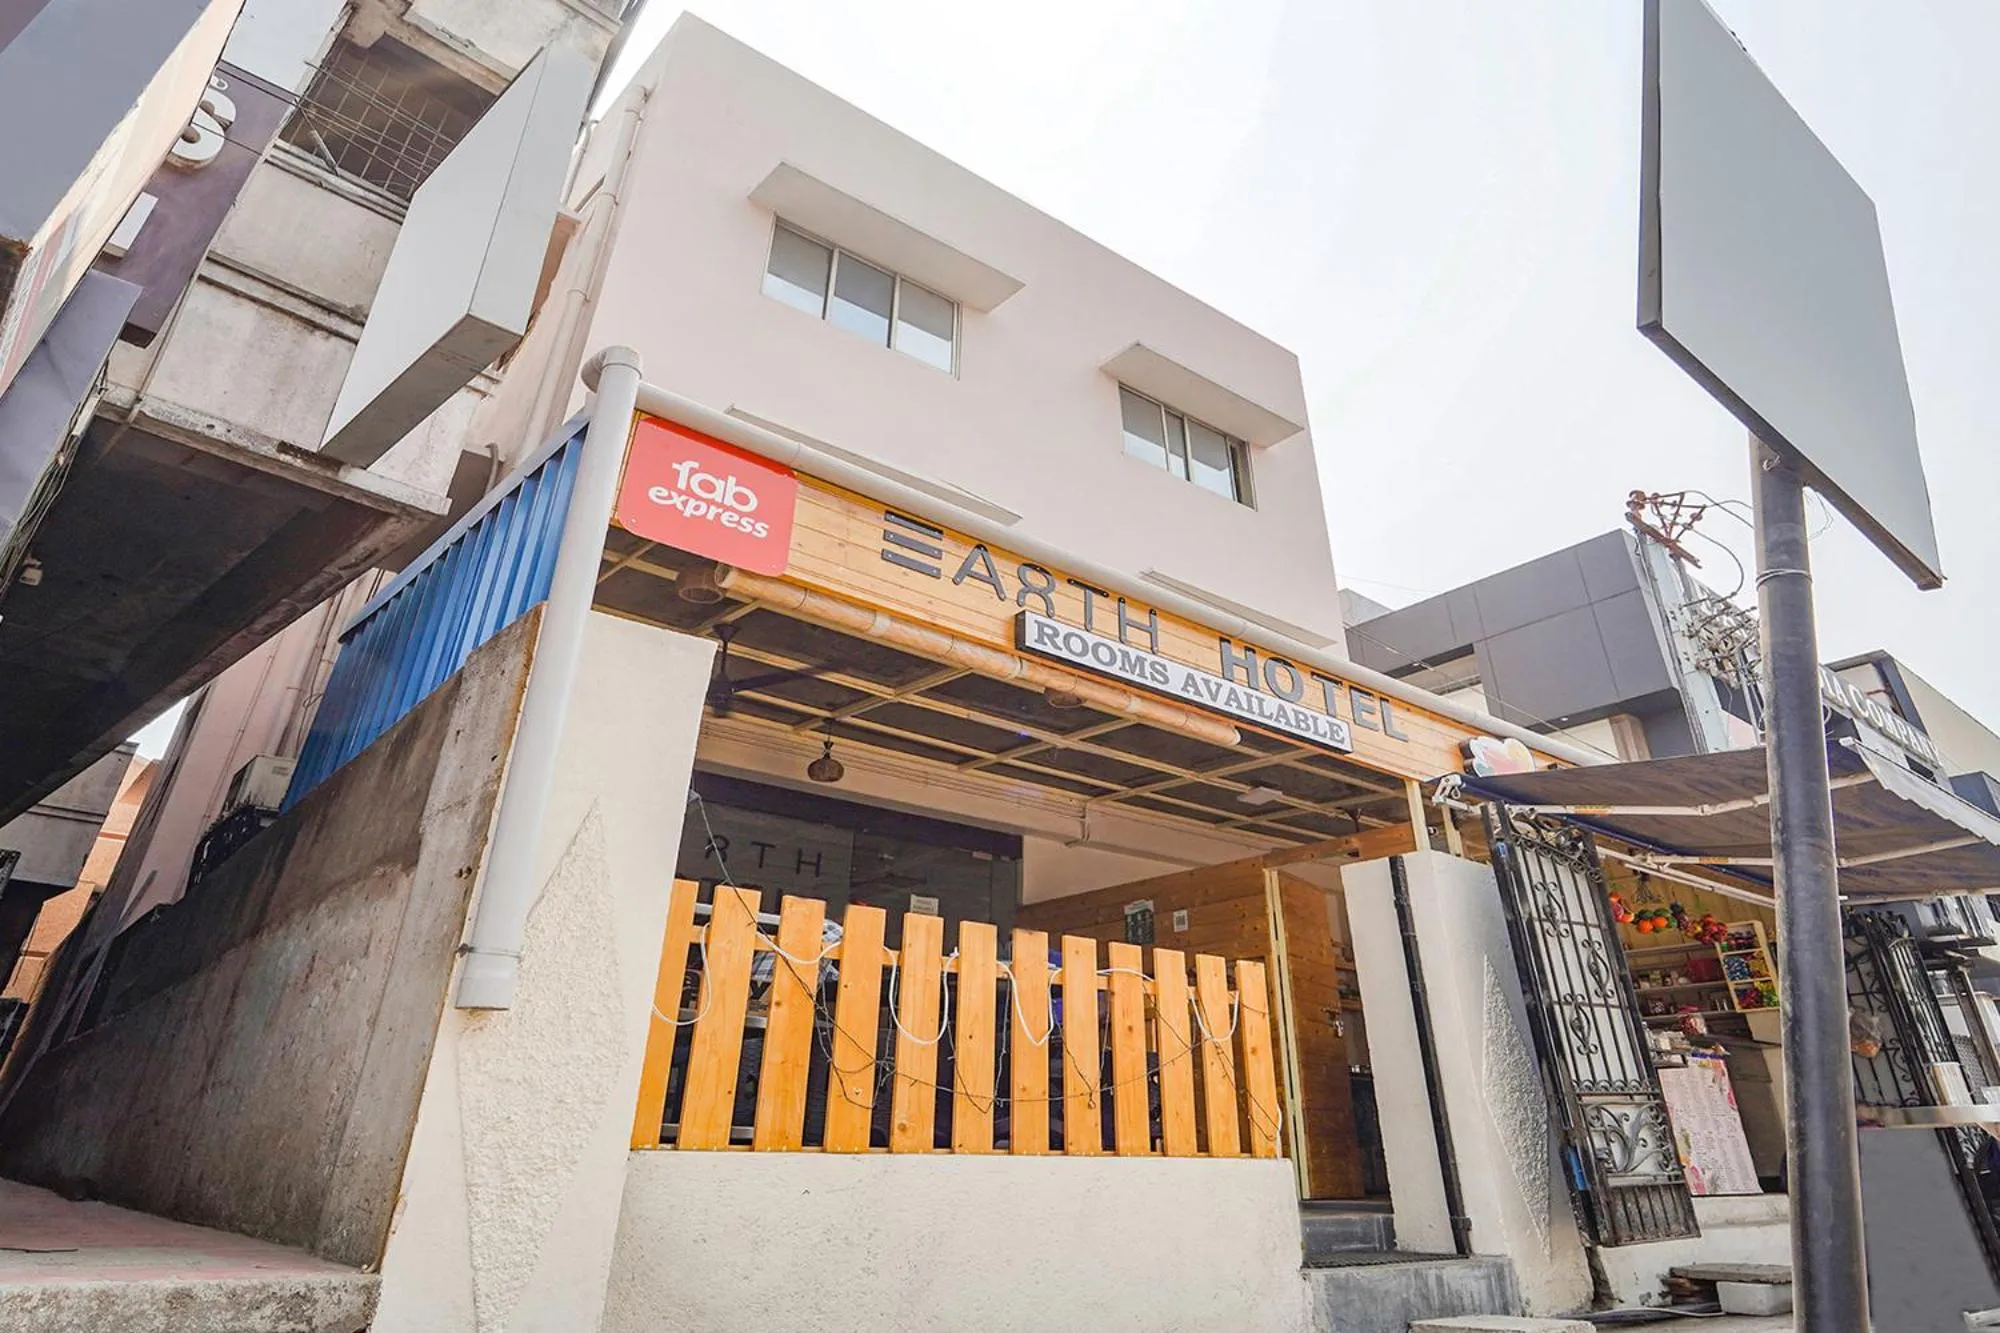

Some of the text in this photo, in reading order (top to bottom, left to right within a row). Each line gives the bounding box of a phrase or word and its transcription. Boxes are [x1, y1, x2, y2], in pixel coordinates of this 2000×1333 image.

[648, 486, 769, 538] express
[671, 461, 759, 513] fab
[1034, 620, 1345, 745] ROOMS AVAILABLE
[1219, 637, 1409, 742] HOTEL
